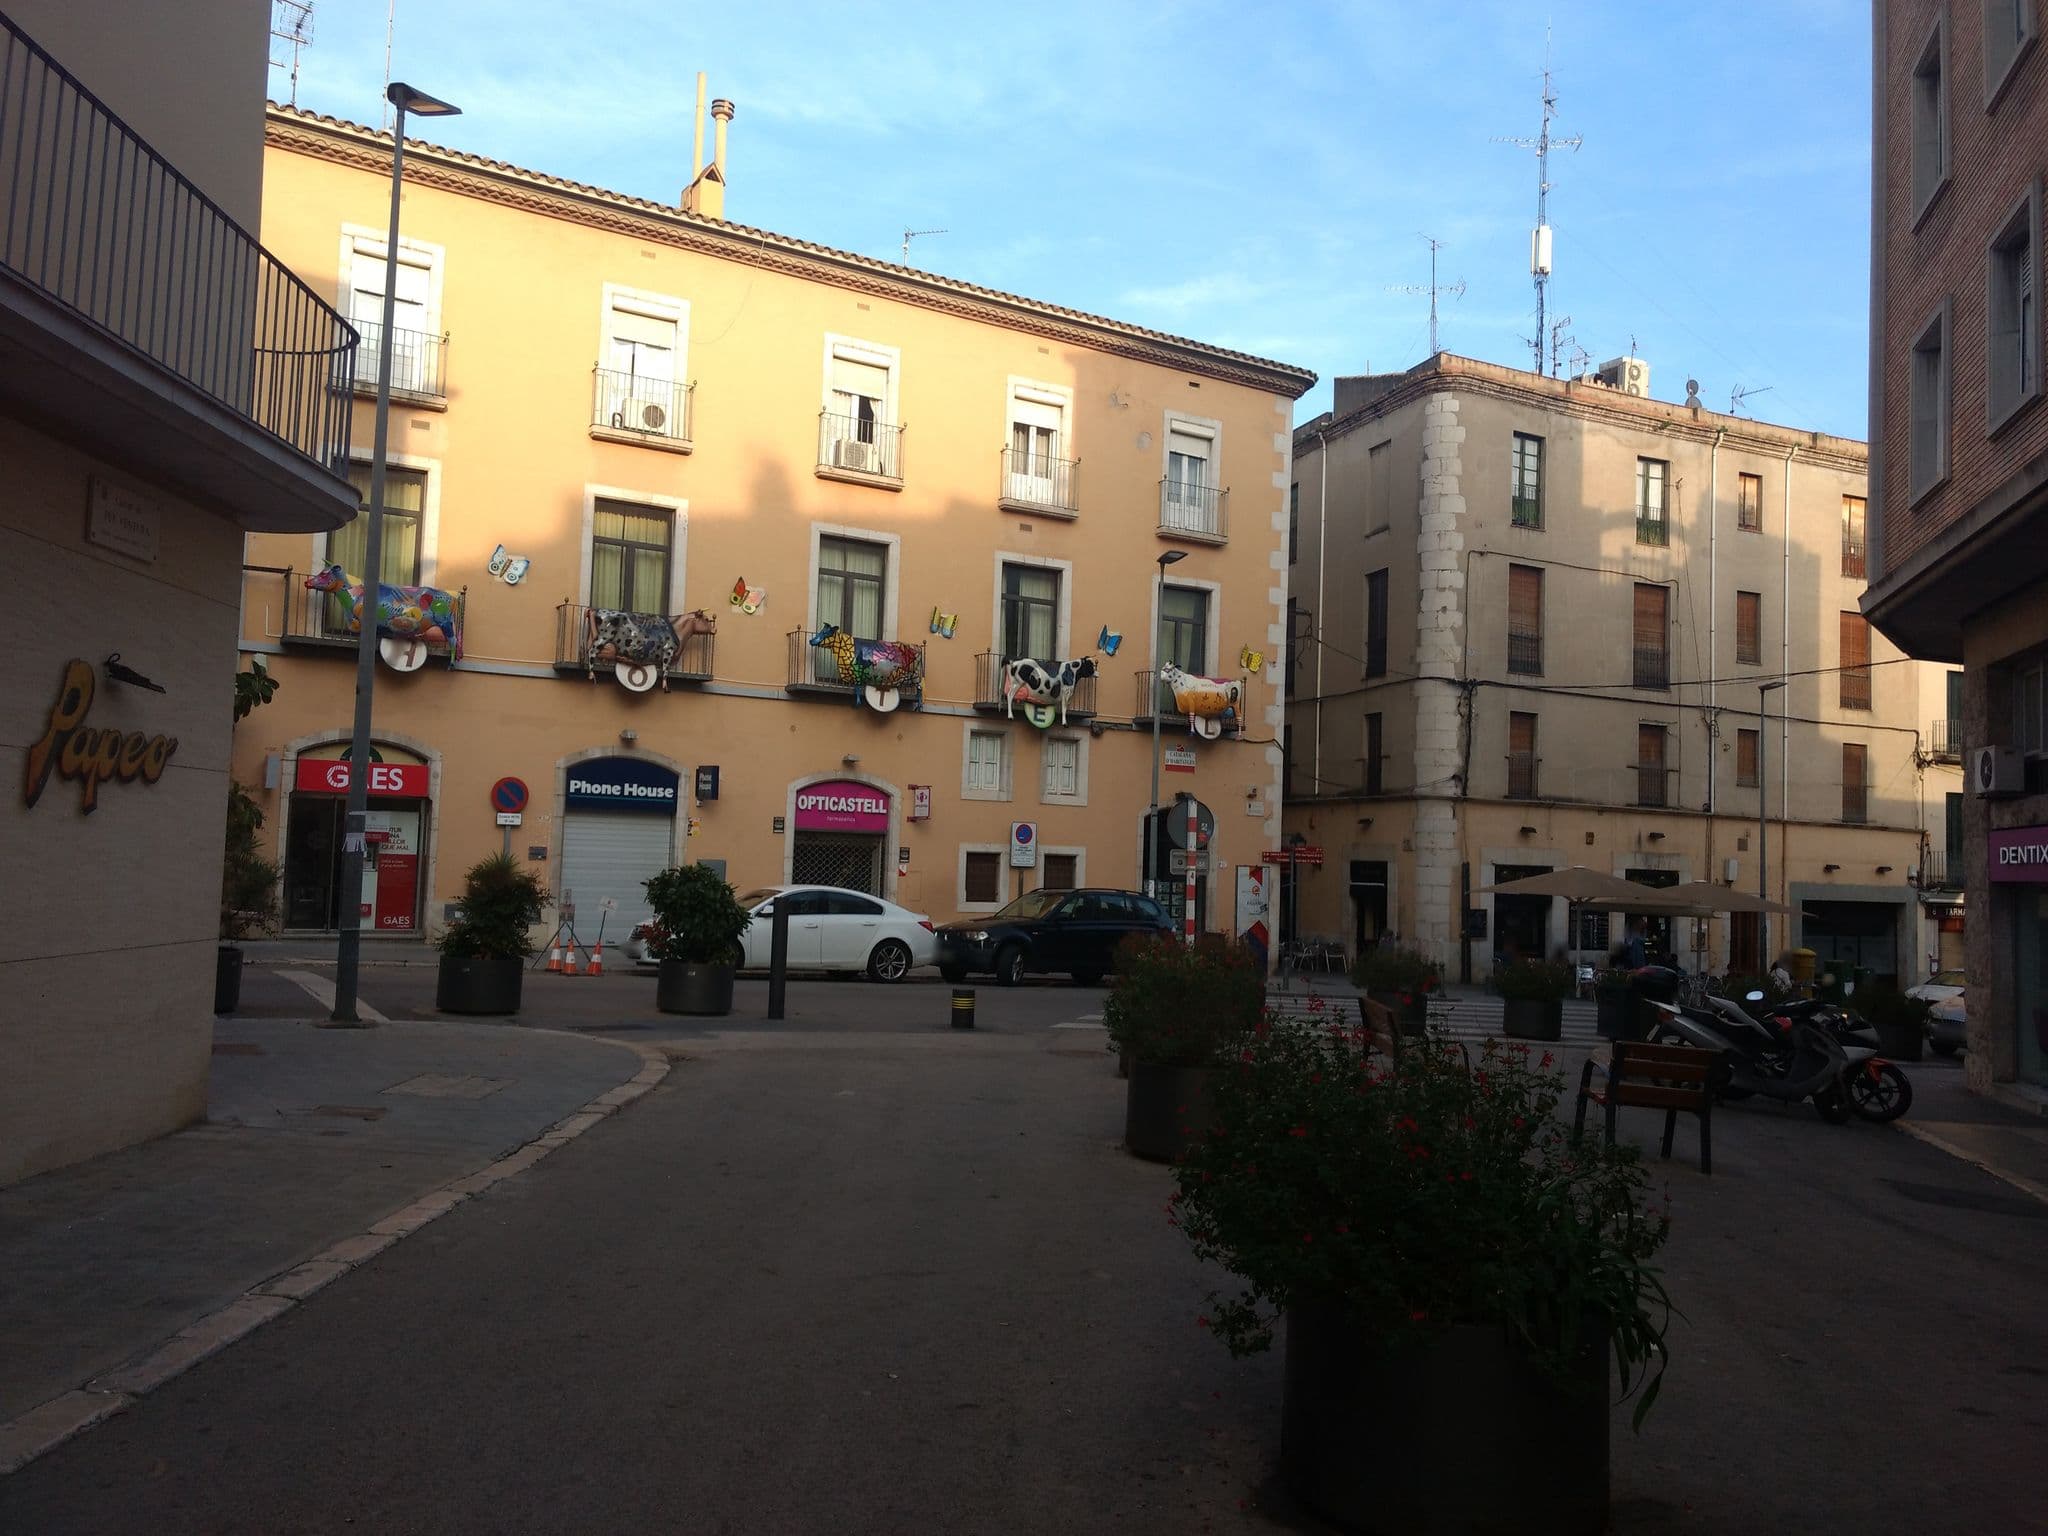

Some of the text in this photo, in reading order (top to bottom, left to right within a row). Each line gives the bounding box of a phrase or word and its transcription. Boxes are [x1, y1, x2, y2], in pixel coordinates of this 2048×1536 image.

[875, 686, 890, 707] T
[1033, 703, 1046, 723] E
[1204, 717, 1216, 736] L
[26, 658, 178, 816] Papeo
[326, 765, 403, 791] GES
[569, 779, 674, 798] Phone House
[797, 795, 888, 814] OPTICASTELL
[1999, 844, 2048, 865] DENTIX
